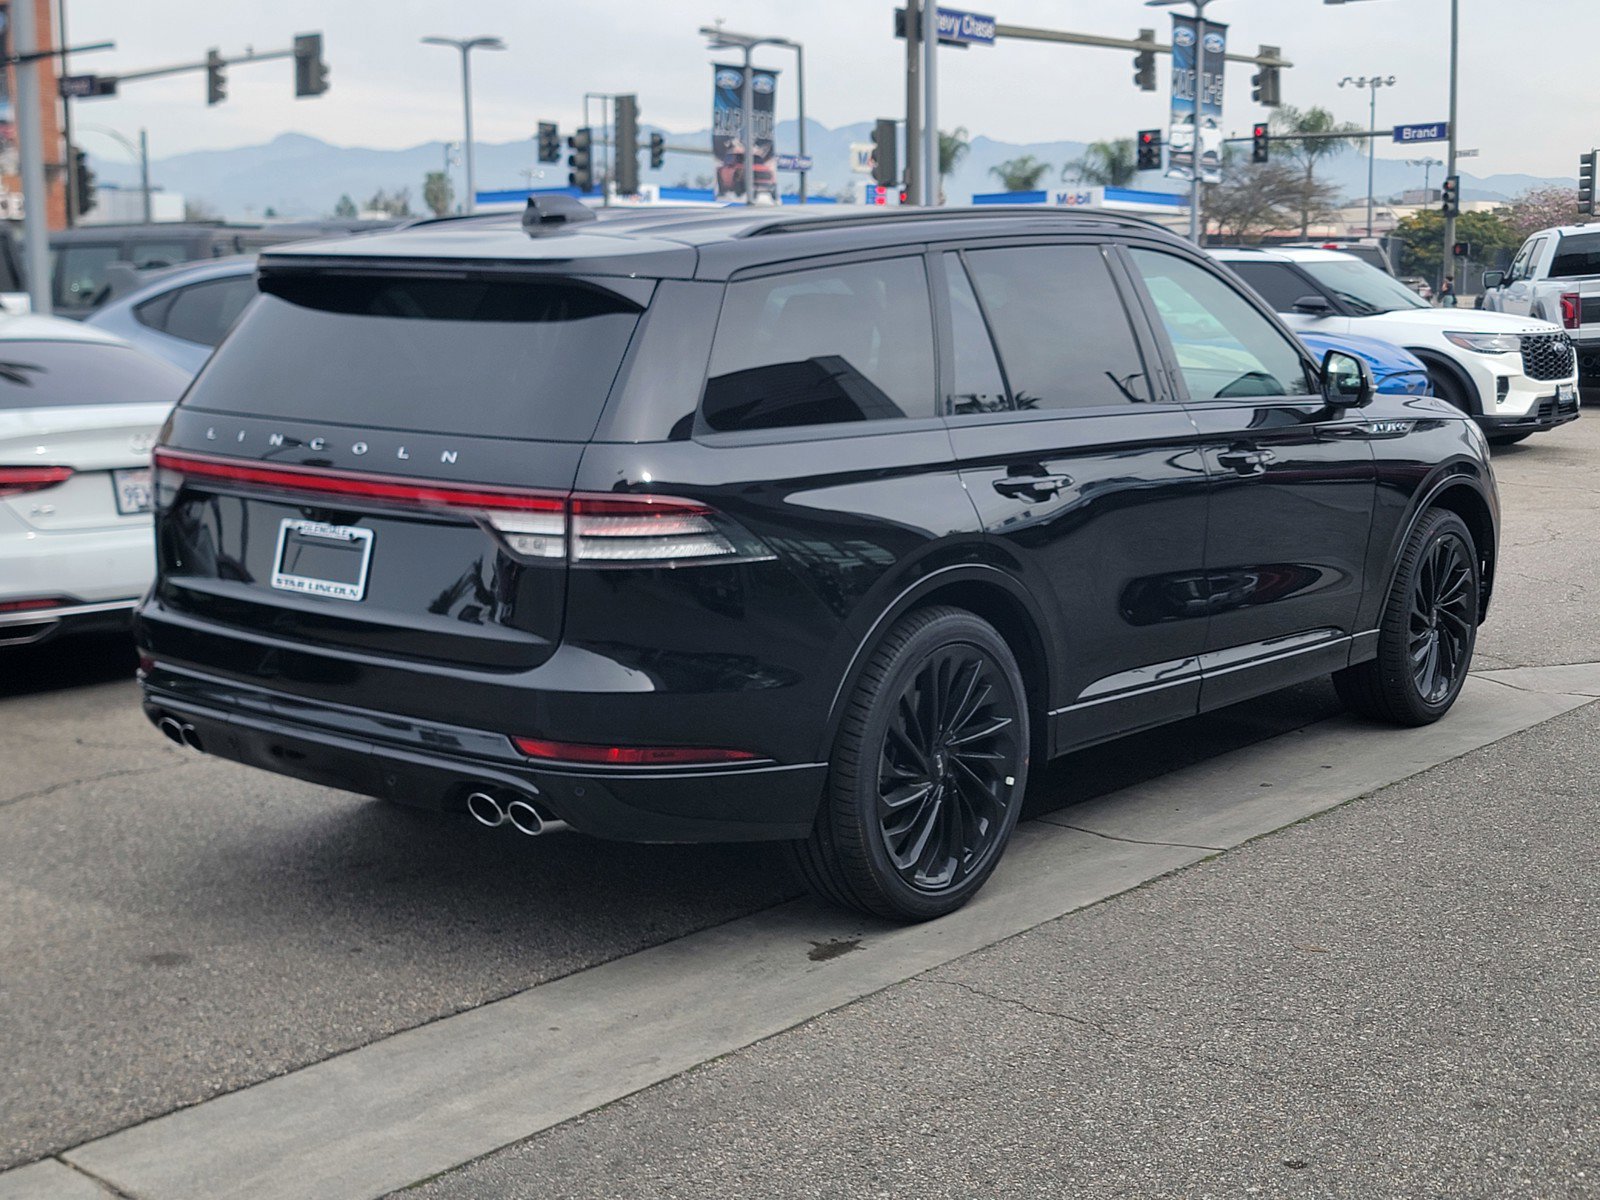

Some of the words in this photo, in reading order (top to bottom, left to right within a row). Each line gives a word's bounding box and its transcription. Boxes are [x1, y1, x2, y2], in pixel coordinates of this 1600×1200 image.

[962, 14, 996, 39] Chase
[1402, 125, 1438, 140] Brand
[206, 427, 459, 465] LINCOLN
